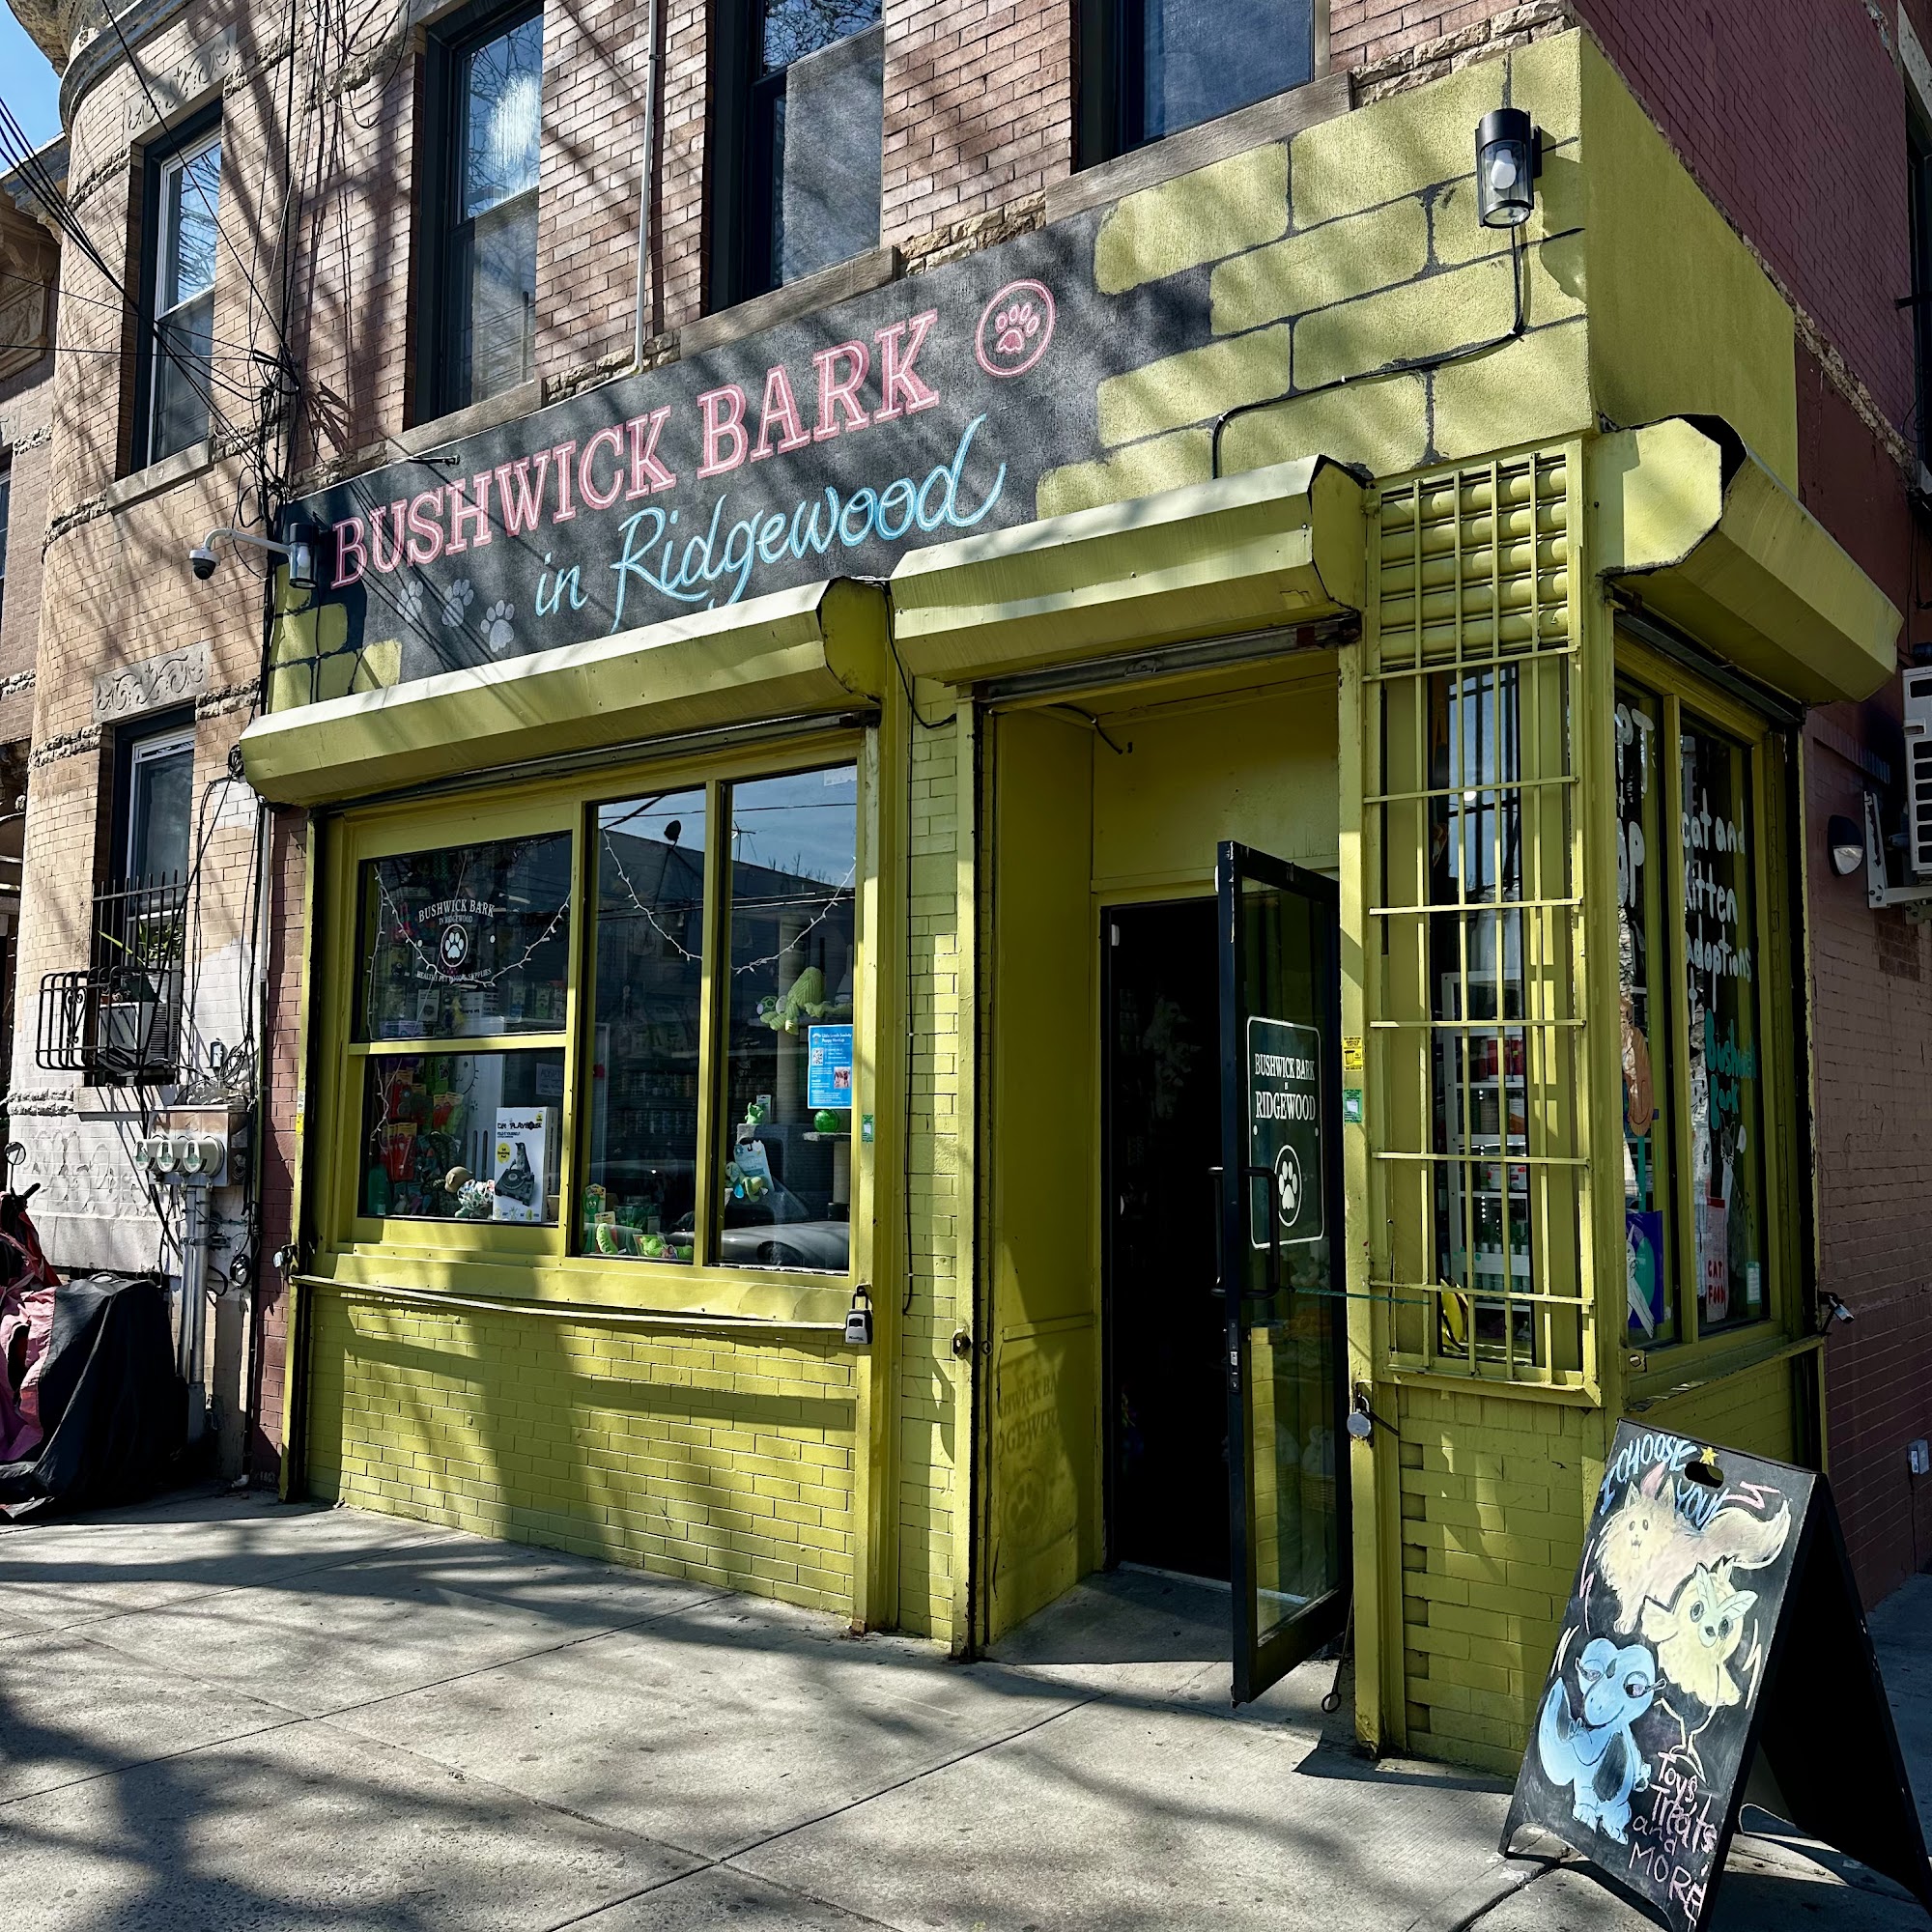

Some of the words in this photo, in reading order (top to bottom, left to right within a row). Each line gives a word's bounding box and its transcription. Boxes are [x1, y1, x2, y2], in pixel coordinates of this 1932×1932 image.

[330, 406, 678, 589] BUSHWICK
[696, 309, 941, 479] BARK
[535, 552, 589, 618] in
[608, 412, 1007, 634] Ridgewood
[1682, 787, 1713, 851] cat
[1715, 798, 1746, 855] and
[418, 898, 468, 923] BUSHWICK
[469, 899, 495, 918] BARK
[1255, 1053, 1295, 1079] BUSHWICK
[1295, 1058, 1316, 1081] BARK
[1255, 1091, 1316, 1121] RIDGEWOOD
[1707, 1260, 1723, 1279] CAT
[1616, 1434, 1698, 1485] CHOOSE
[1633, 1815, 1678, 1857] and
